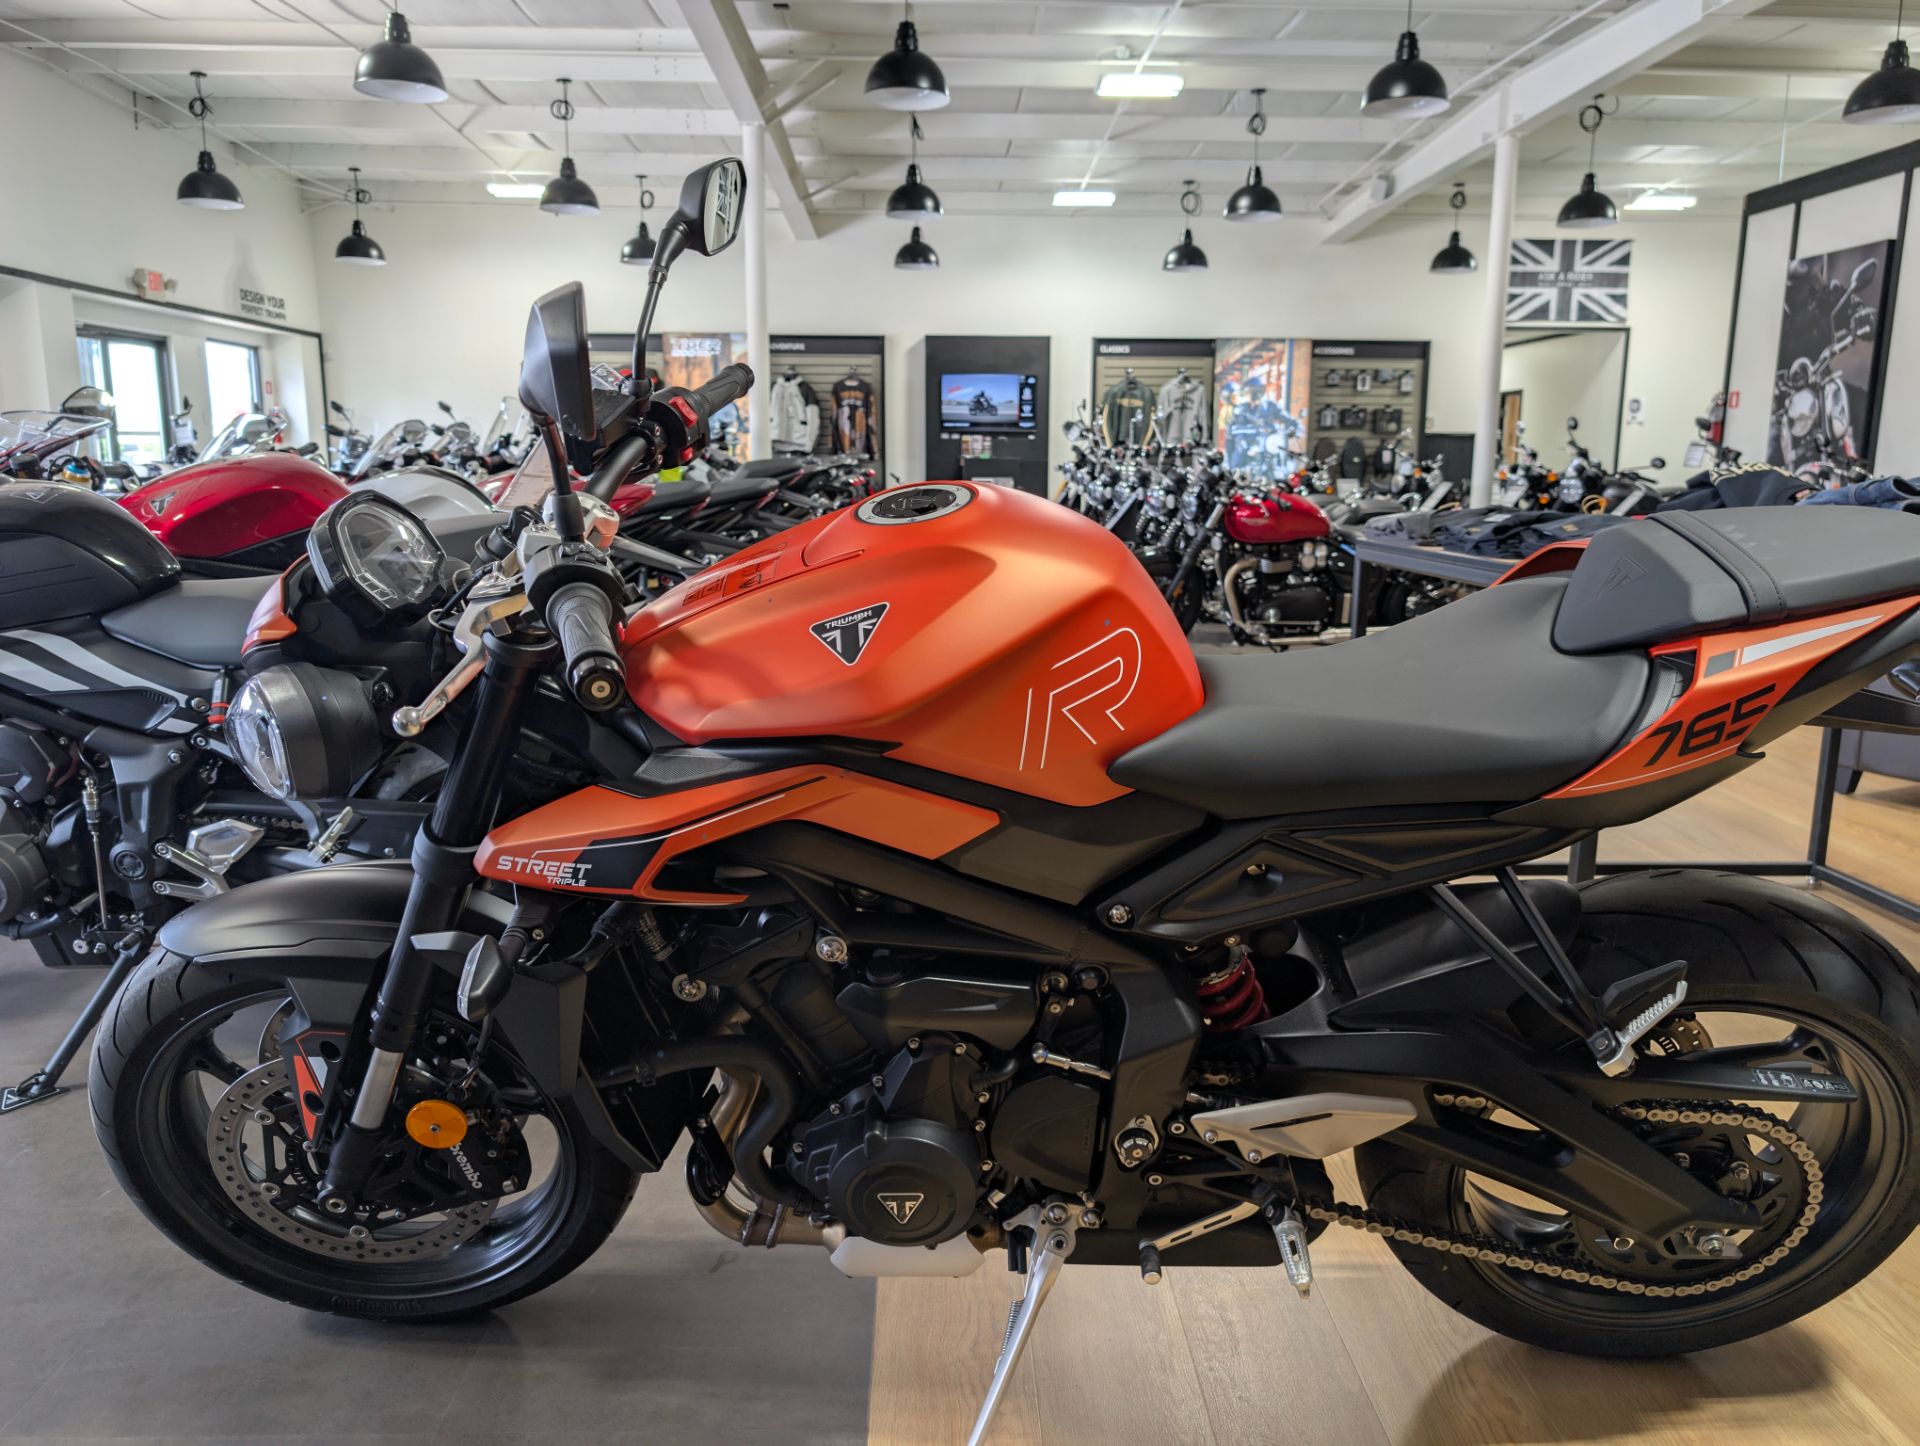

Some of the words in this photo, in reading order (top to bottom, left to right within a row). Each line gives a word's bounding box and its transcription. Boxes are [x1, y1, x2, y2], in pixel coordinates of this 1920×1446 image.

[240, 288, 265, 305] DESIGN
[267, 296, 285, 310] YOUR
[824, 610, 872, 629] TRIUMPH
[1643, 682, 1776, 768] 765
[496, 855, 592, 879] STREET
[546, 876, 587, 887] TRIPLE
